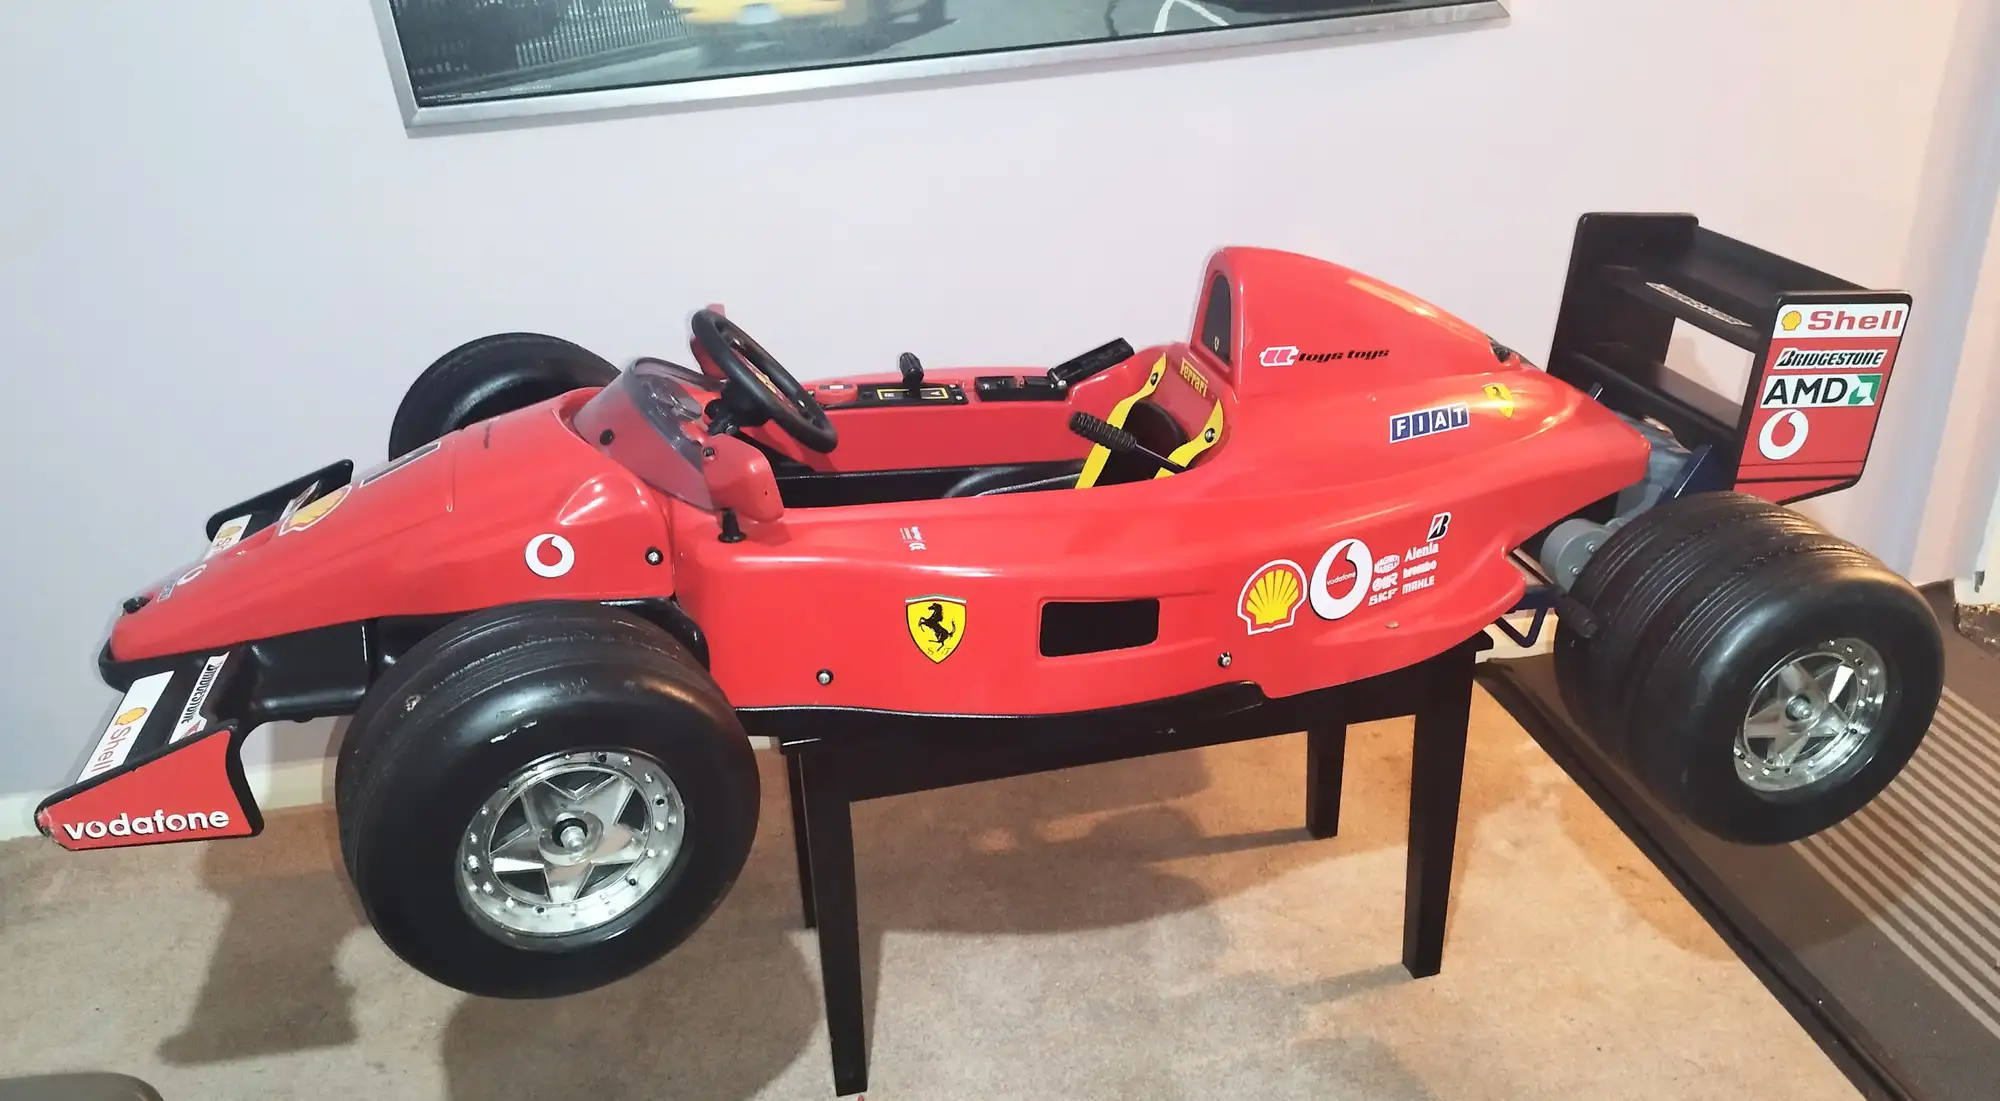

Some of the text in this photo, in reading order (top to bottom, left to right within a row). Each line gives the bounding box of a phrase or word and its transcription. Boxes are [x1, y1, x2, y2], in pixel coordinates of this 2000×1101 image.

[1808, 310, 1904, 330] Shell
[1299, 350, 1389, 363] toys toys
[1775, 350, 1885, 368] BRIDGESTONE
[1180, 357, 1208, 398] Ferrari
[1762, 377, 1848, 405] AMD
[1395, 406, 1465, 438] FIAT
[1402, 575, 1435, 594] MAHLE
[91, 726, 132, 772] Shell
[63, 809, 230, 840] vodafone
